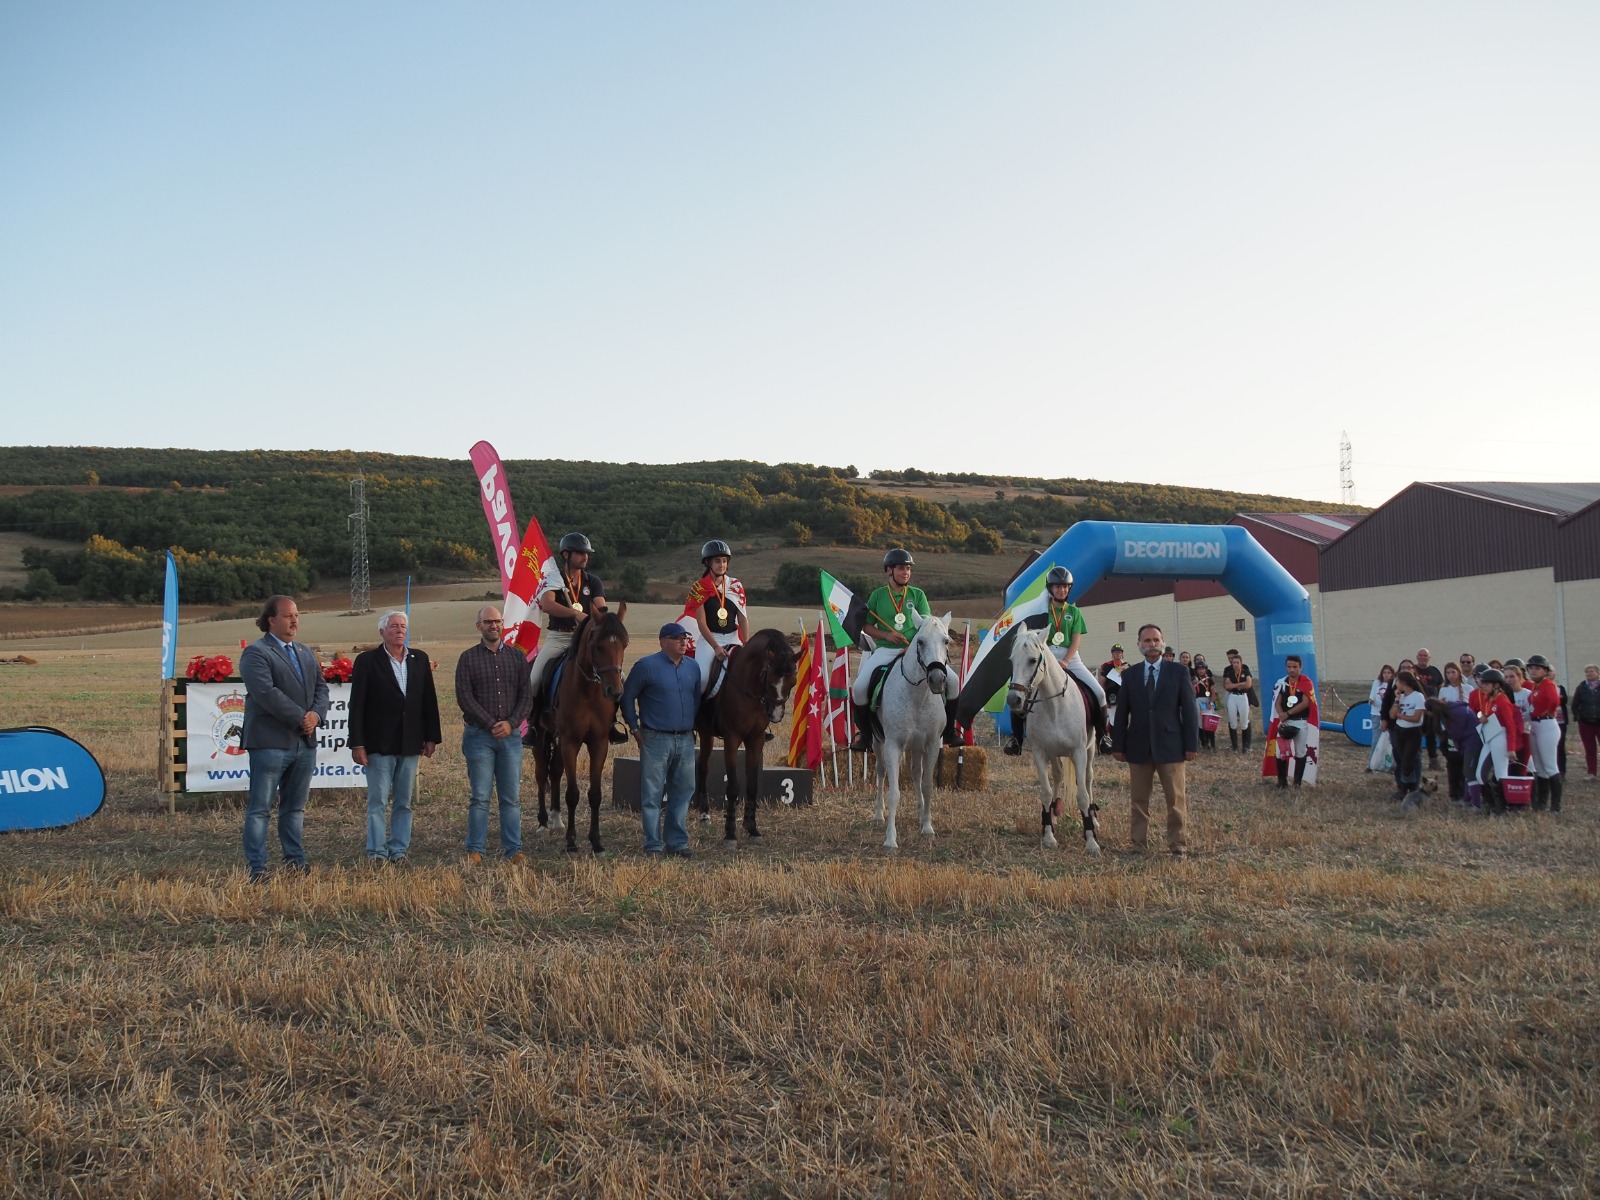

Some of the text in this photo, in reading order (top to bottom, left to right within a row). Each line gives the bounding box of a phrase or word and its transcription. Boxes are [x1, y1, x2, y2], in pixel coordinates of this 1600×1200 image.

[1124, 541, 1220, 558] DECATHLON
[328, 700, 349, 711] ra
[320, 719, 348, 730] arr
[780, 778, 795, 804] 3
